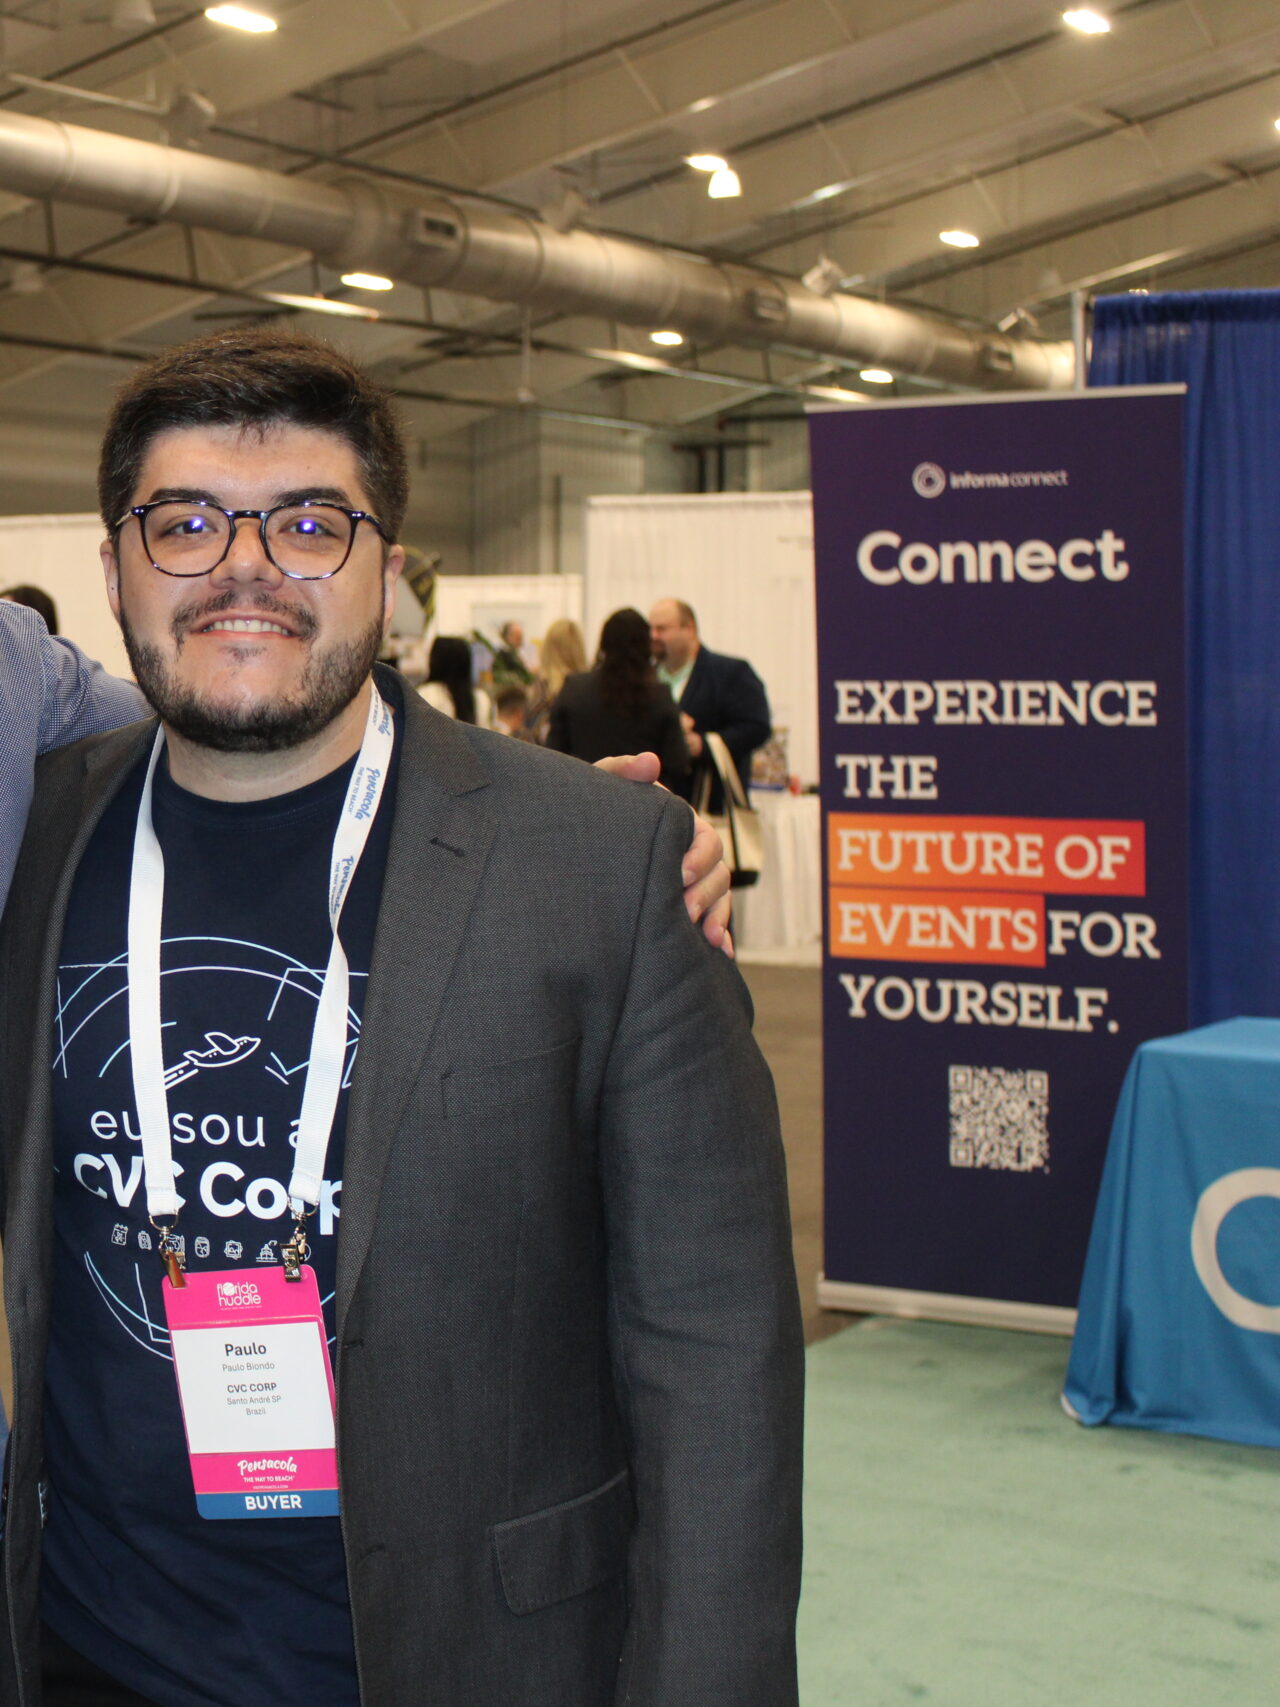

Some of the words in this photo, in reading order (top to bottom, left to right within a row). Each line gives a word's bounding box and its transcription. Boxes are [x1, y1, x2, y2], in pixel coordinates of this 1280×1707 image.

[857, 530, 1129, 586] Connect
[834, 680, 1157, 726] EXPERIENCE
[835, 755, 938, 799] THE
[354, 767, 381, 820] Pensacola
[837, 828, 1044, 877] FUTURE
[1055, 834, 1131, 880] OF
[838, 902, 1038, 952] EVENTS
[1048, 910, 1161, 959] FOR
[839, 974, 1120, 1033] YOURSELF.
[172, 1112, 266, 1147] sou
[219, 1293, 262, 1306] huddle
[224, 1341, 267, 1357] Paulo
[222, 1363, 245, 1373] Paulo
[246, 1362, 276, 1371] Biondo
[226, 1397, 248, 1406] Santo
[271, 1394, 282, 1403] SP
[227, 1384, 248, 1394] CVC
[249, 1382, 277, 1393] CORP
[245, 1406, 267, 1416] Brazil
[237, 1456, 298, 1476] Pensacola
[244, 1494, 303, 1511] BUYER
